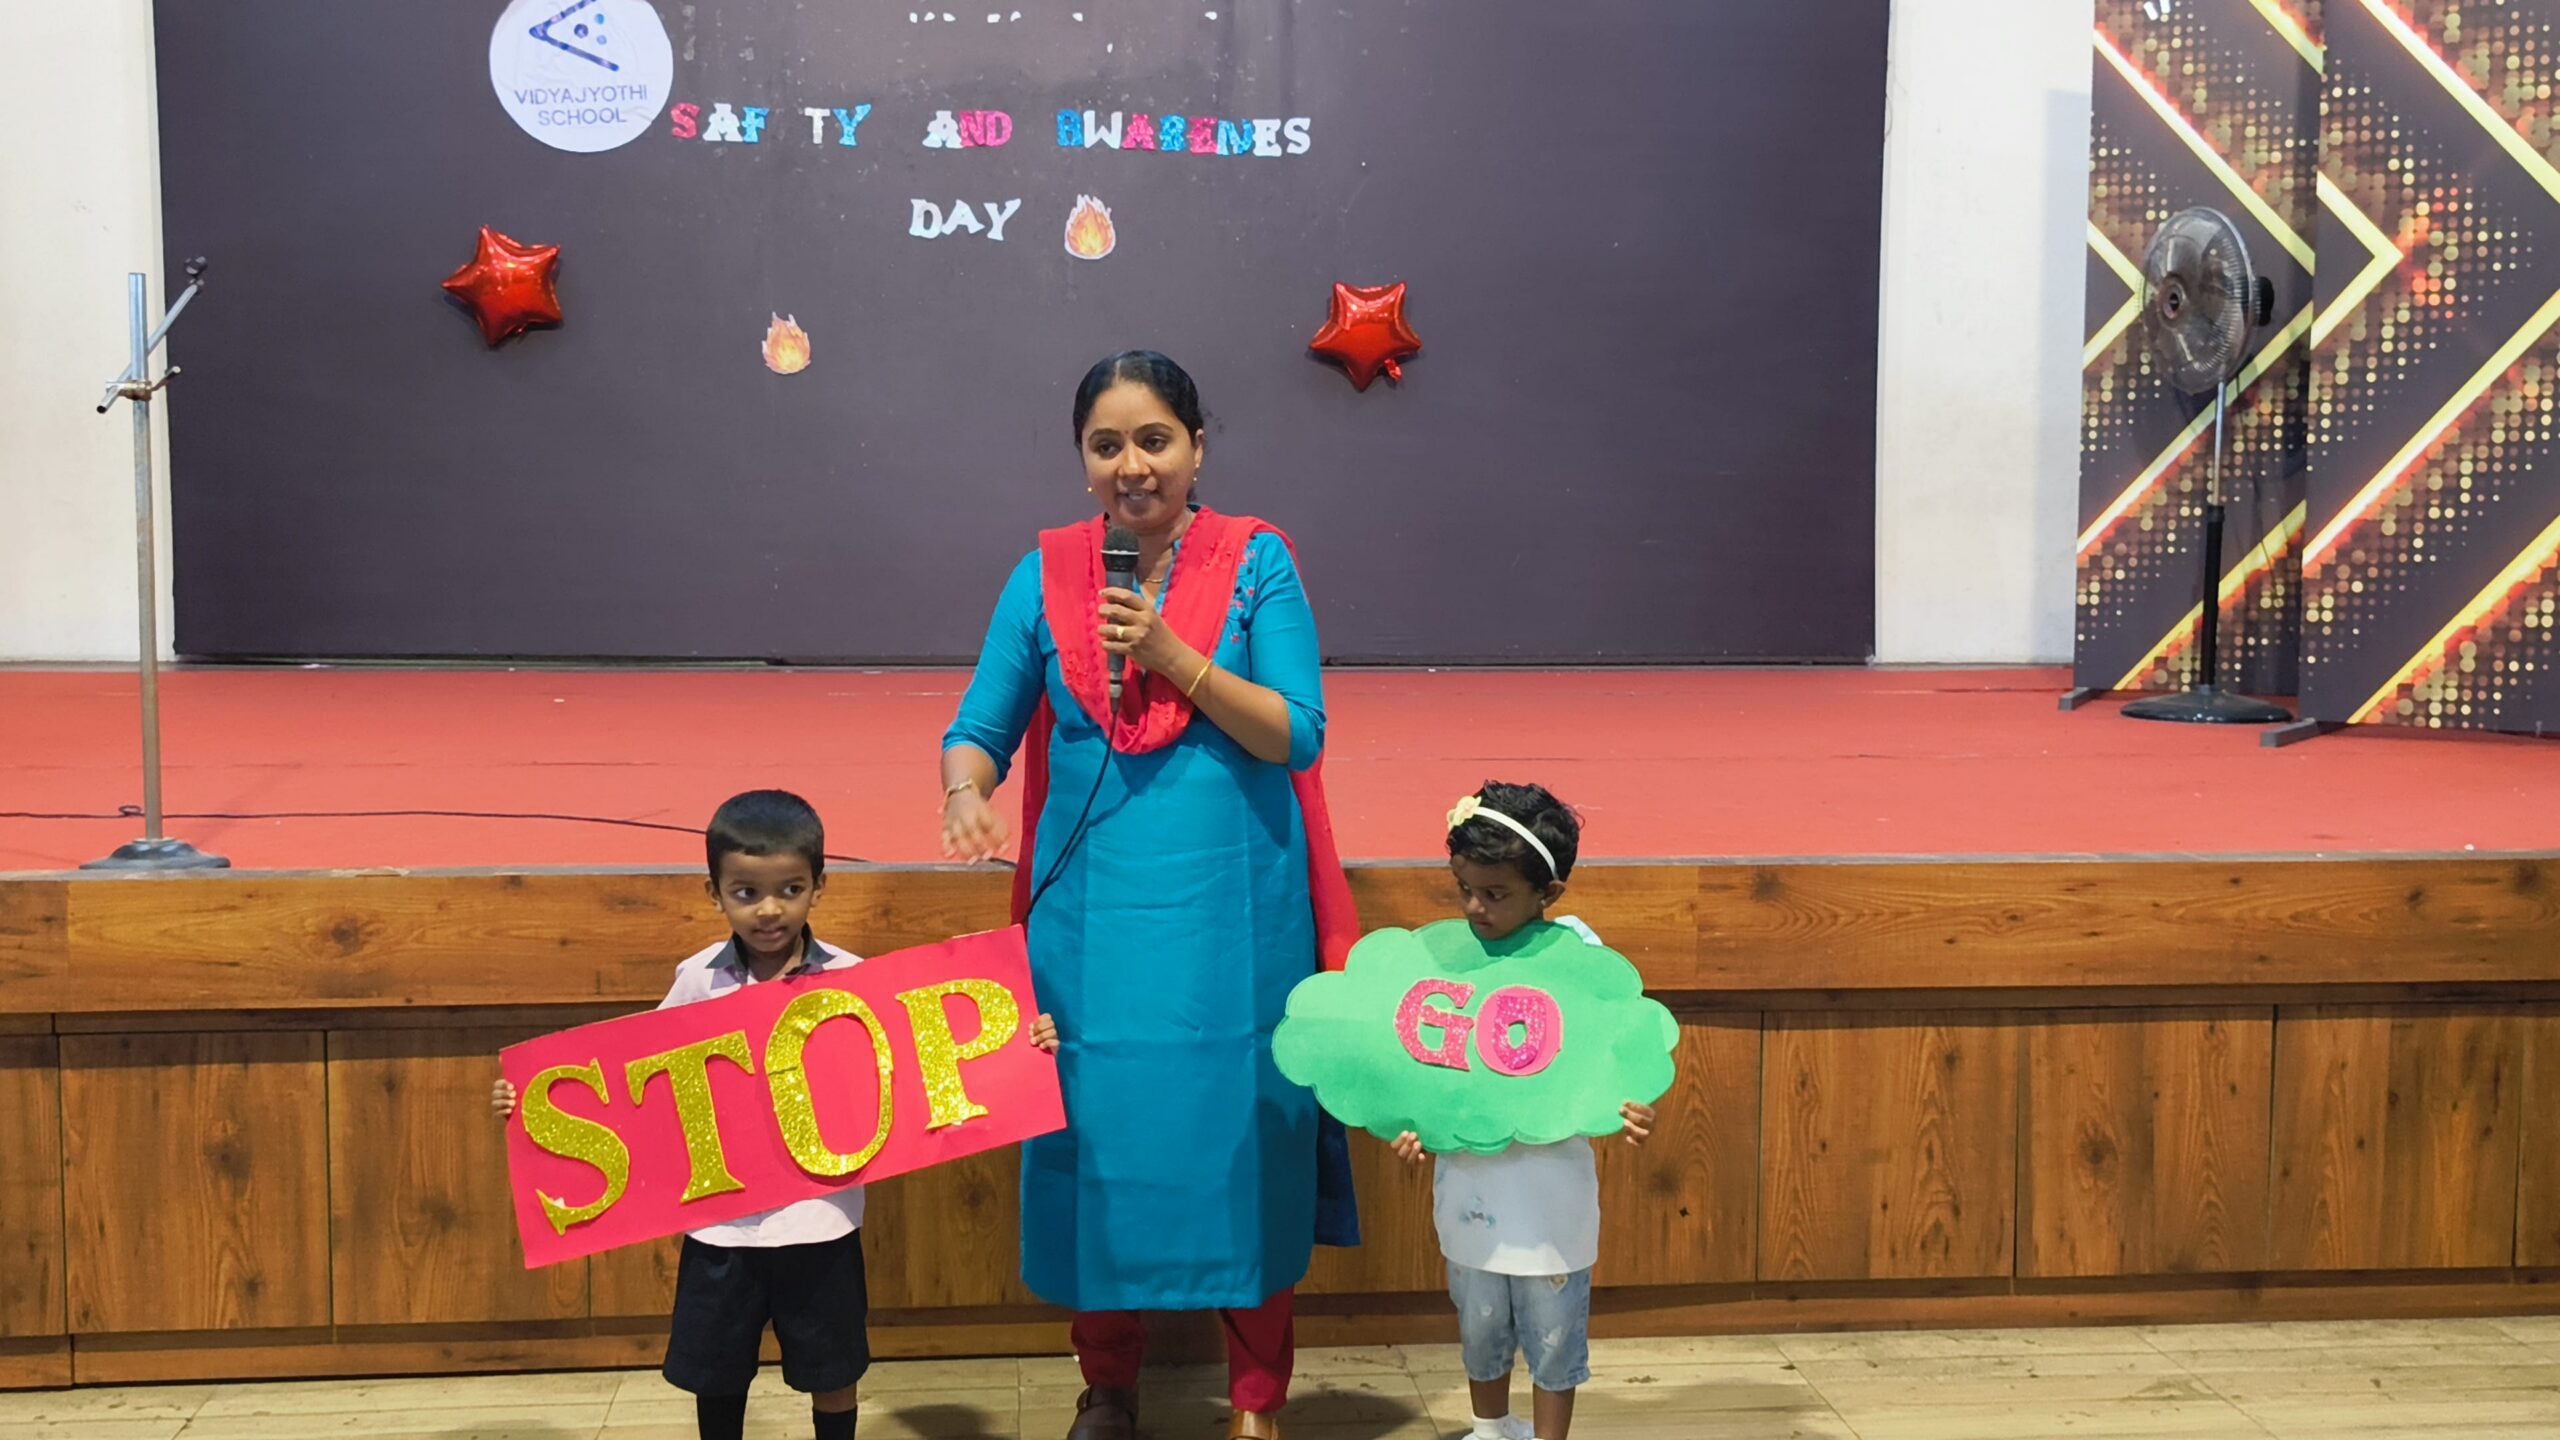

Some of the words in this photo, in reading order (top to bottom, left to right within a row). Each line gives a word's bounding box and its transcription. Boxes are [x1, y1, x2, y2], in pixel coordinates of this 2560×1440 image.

[514, 84, 648, 105] VIDYAJYOTHI
[538, 107, 627, 126] SCHOOL
[922, 110, 1013, 149] AND
[1056, 109, 1312, 157] AWARENES
[909, 199, 1021, 241] DAY
[1395, 979, 1563, 1077] GO
[521, 979, 1019, 1235] STOP
